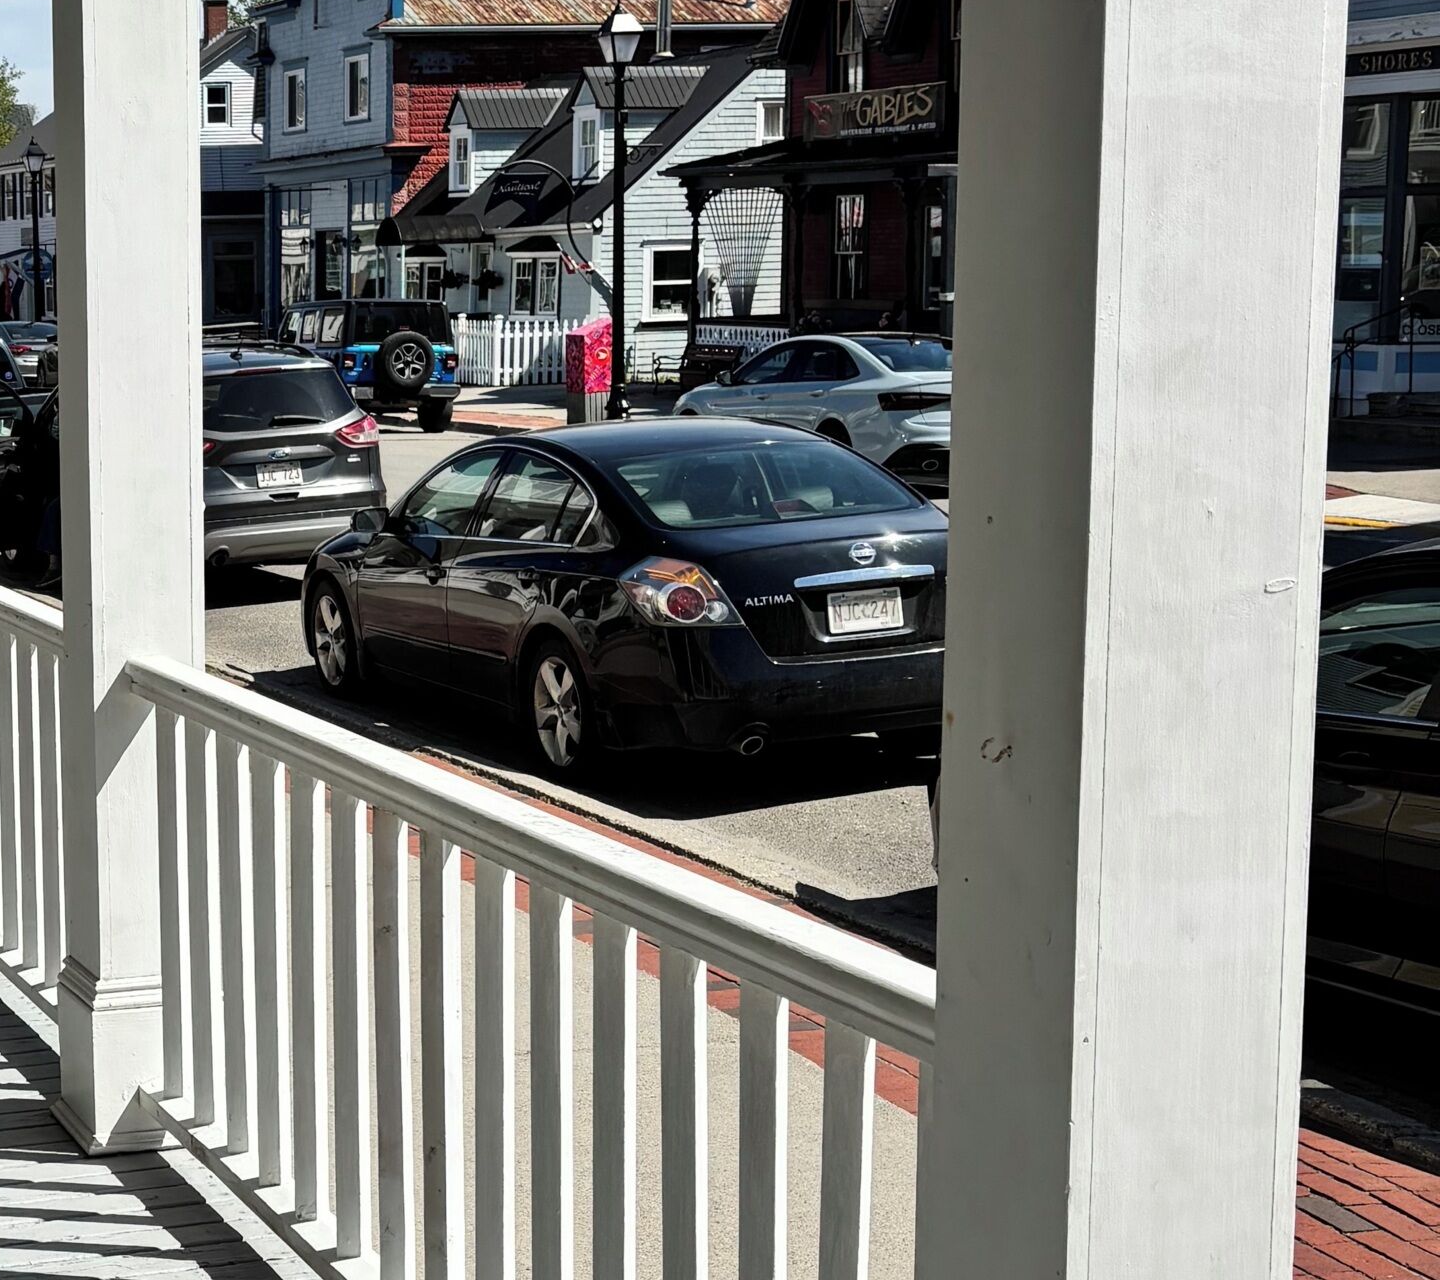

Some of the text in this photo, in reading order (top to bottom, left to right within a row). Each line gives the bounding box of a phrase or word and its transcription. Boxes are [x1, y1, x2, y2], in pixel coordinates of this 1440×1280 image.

[1360, 51, 1433, 72] SHORES
[855, 86, 933, 127] GABLES
[744, 593, 795, 607] ALTIMA
[870, 599, 898, 619] 247
